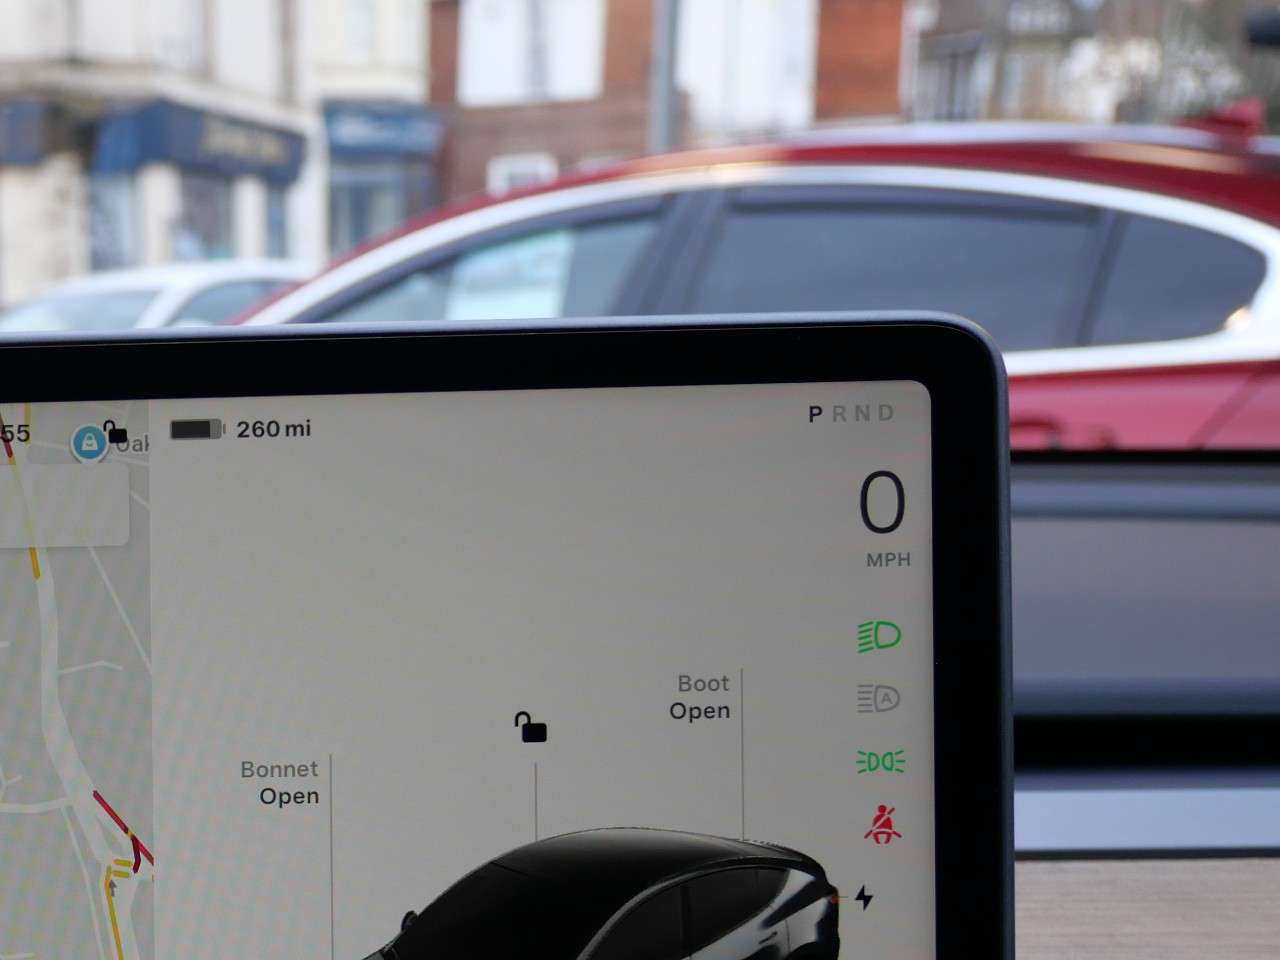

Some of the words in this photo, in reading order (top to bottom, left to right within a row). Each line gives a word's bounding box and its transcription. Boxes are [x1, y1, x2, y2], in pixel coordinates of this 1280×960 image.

[808, 405, 823, 423] P
[833, 404, 848, 422] R
[855, 404, 871, 422] N
[879, 403, 895, 421] D
[236, 420, 280, 438] 260
[285, 419, 311, 437] mi
[859, 470, 906, 535] 0
[866, 551, 912, 568] MPH
[678, 674, 730, 693] Boot
[669, 702, 730, 724] Open
[241, 760, 319, 779] Bonnet
[259, 787, 320, 808] Open
